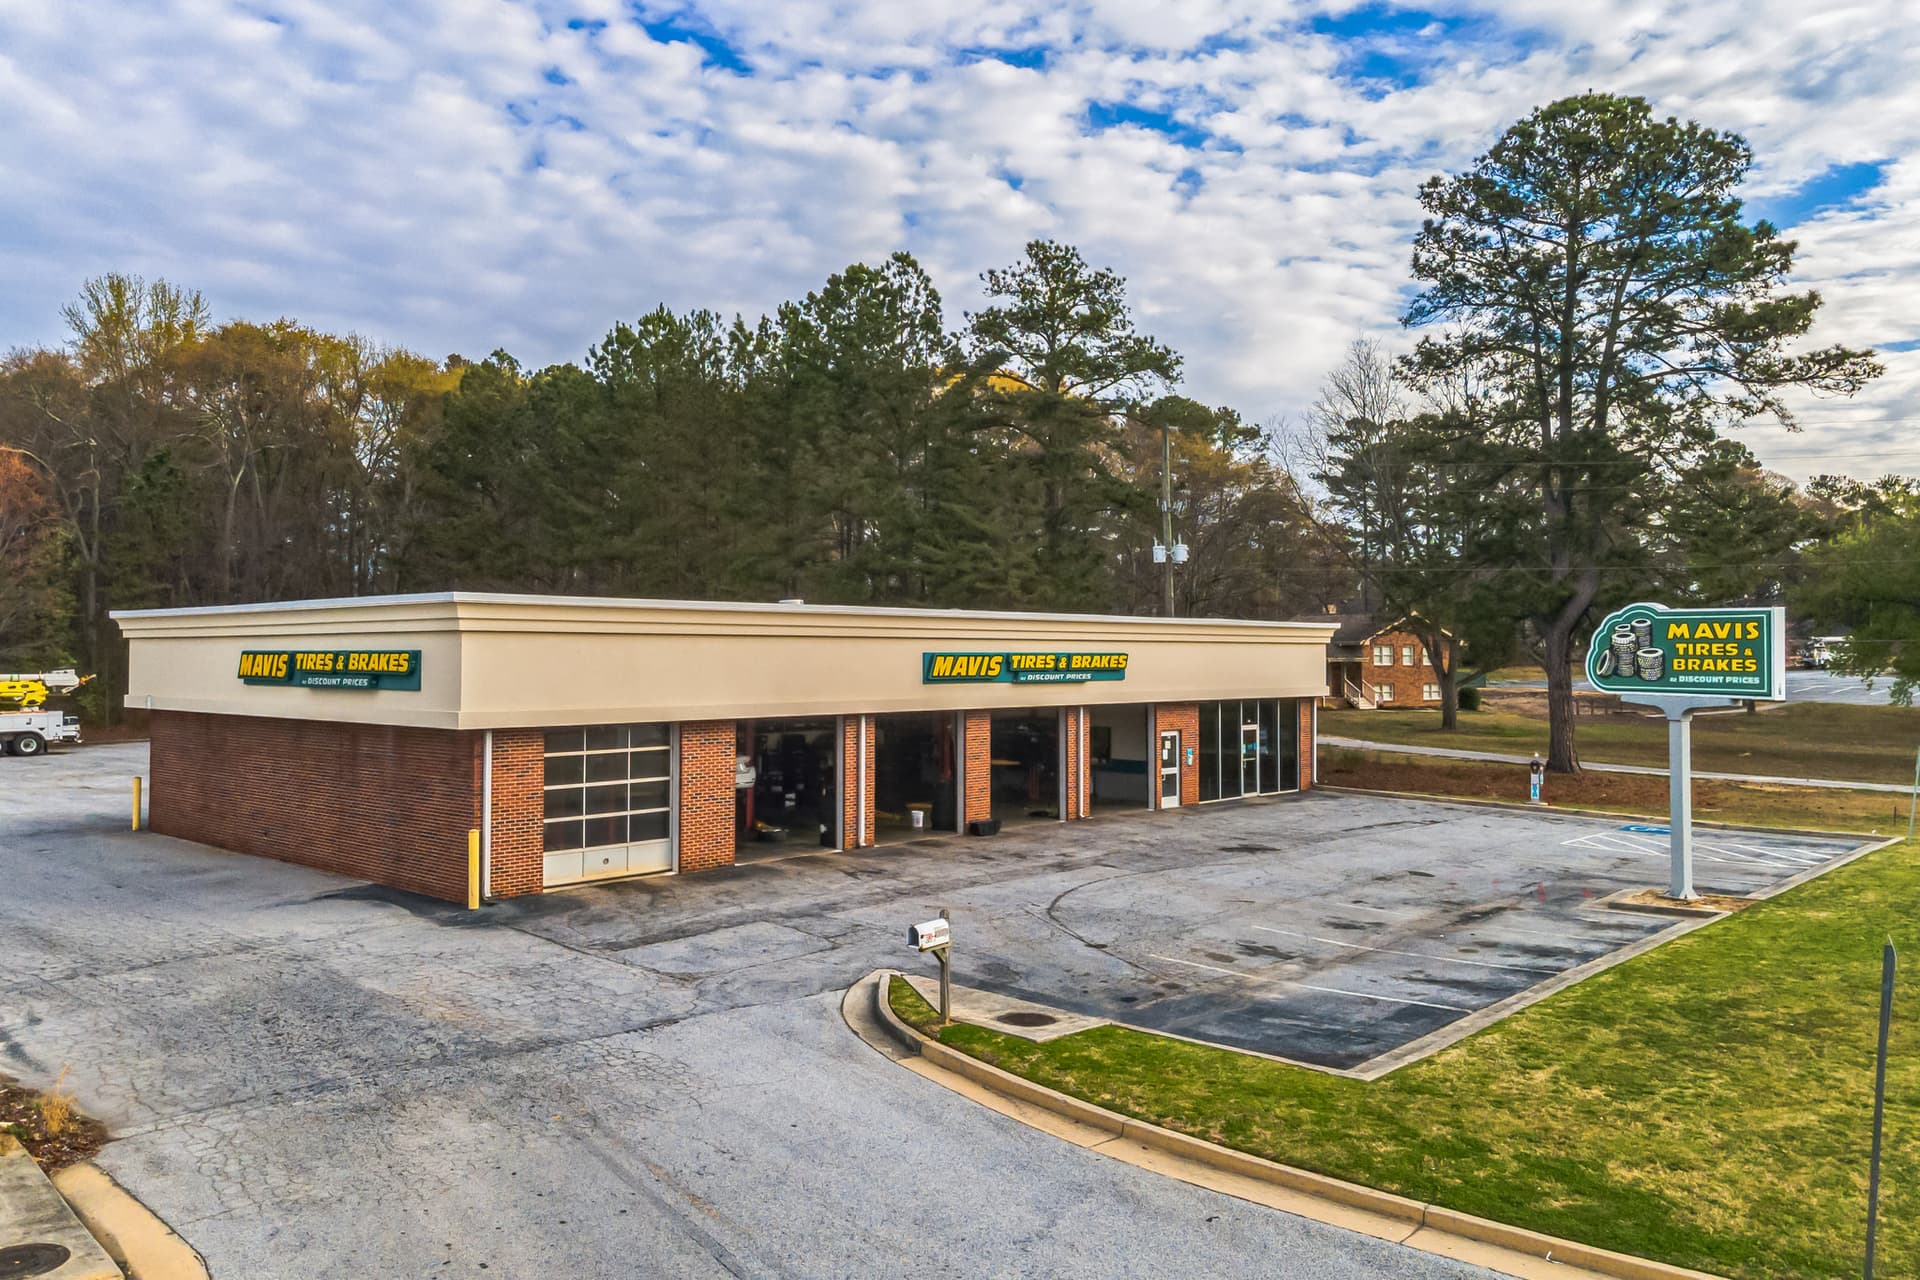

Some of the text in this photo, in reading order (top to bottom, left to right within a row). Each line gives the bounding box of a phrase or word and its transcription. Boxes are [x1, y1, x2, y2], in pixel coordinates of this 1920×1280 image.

[1667, 622, 1760, 640] MAVIS
[1675, 643, 1753, 656] TIRES &
[239, 653, 410, 677] MAVIS TIRES & BRAKES
[932, 655, 1128, 677] MAVIS TIRES & BRAKES
[1672, 658, 1757, 672] BRAKES
[307, 677, 340, 686] DISCOUNT
[342, 678, 368, 687] PRICES
[1027, 673, 1064, 681] DISCOUNT
[1679, 675, 1724, 683] DISCOUNT
[1725, 676, 1760, 684] PRICES
